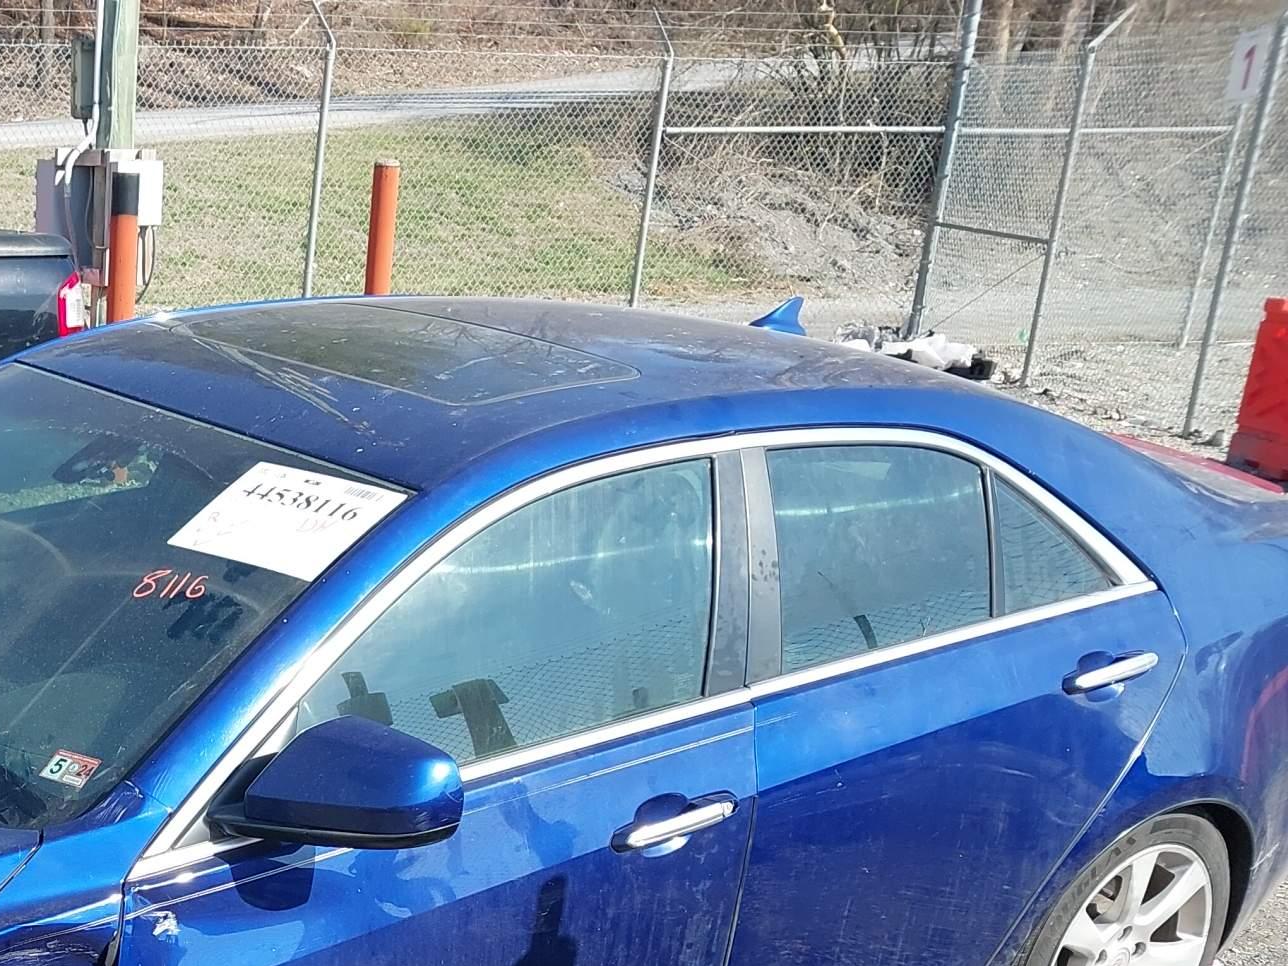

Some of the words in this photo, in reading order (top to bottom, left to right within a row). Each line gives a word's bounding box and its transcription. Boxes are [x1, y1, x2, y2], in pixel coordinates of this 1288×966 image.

[1240, 44, 1257, 91] 1
[242, 483, 362, 521] 44538116
[132, 568, 209, 600] 8116
[49, 758, 68, 775] 5
